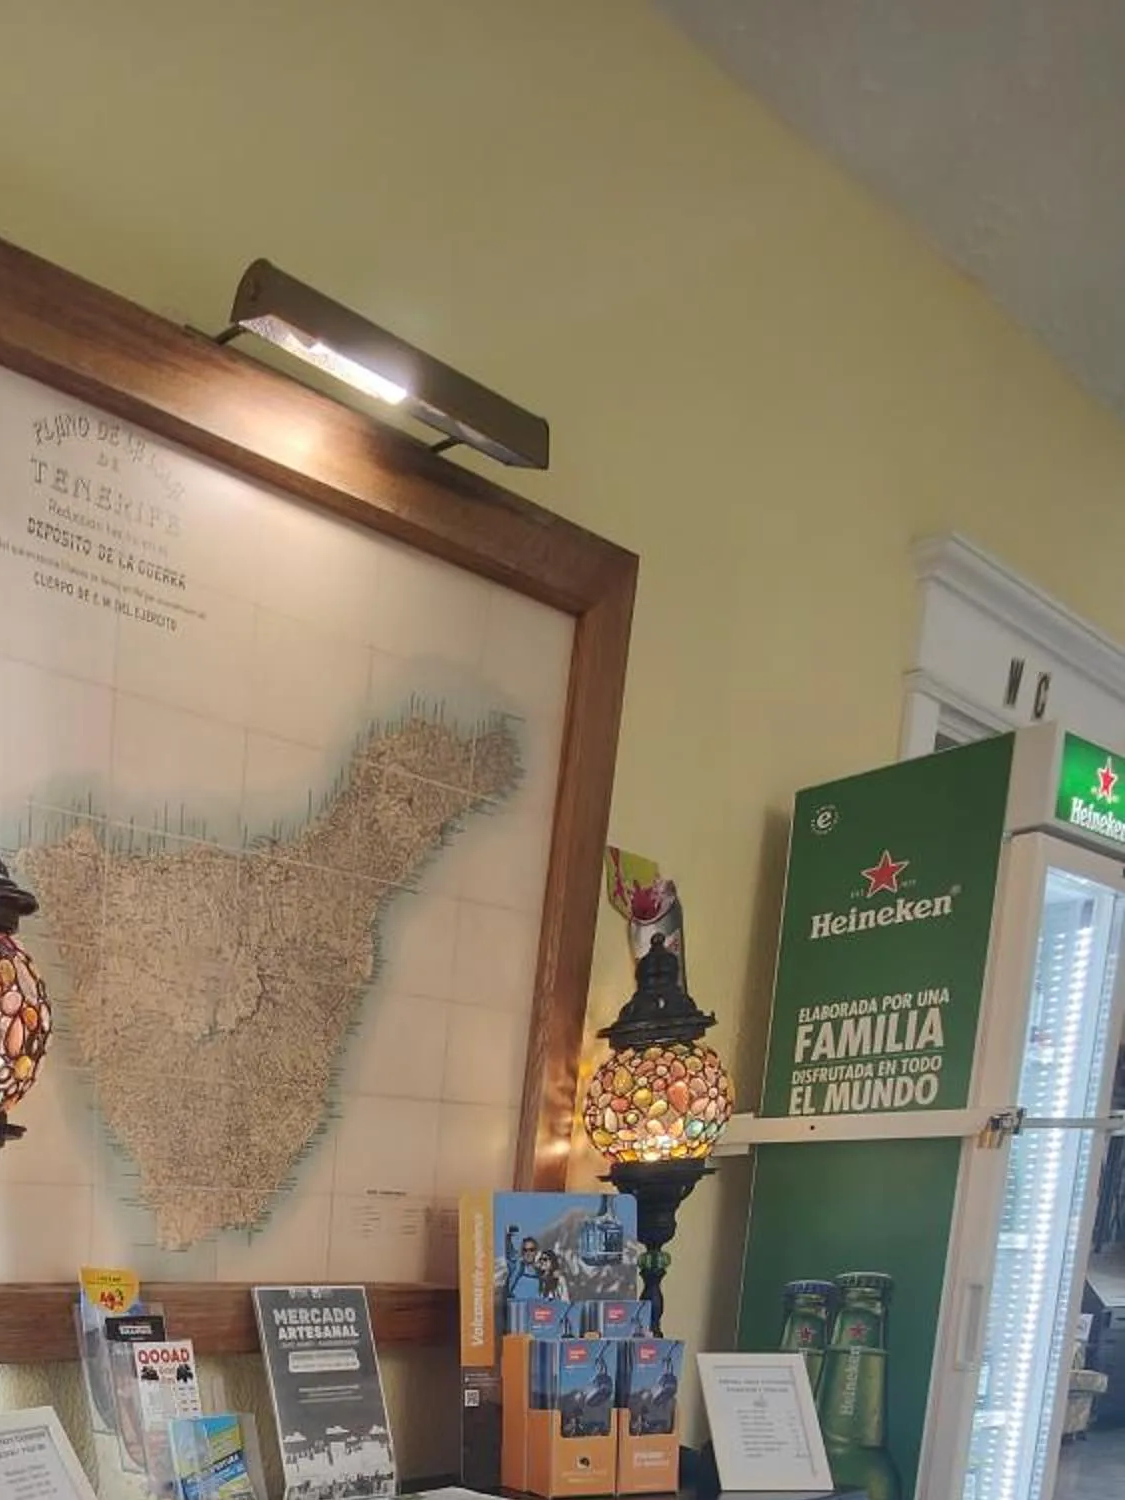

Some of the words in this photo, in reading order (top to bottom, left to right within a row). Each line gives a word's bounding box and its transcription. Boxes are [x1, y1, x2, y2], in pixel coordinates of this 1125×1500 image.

[29, 453, 183, 536] TENERIFE
[97, 543, 114, 564] DE
[1004, 657, 1052, 719] WC
[810, 895, 953, 939] Heineken
[798, 998, 879, 1023] ELABORADA
[881, 992, 913, 1011] POR
[916, 987, 950, 1007] UNA
[794, 1007, 945, 1064] FAMILIA
[791, 1063, 875, 1085] DISFRUTADA
[878, 1061, 897, 1076] EN
[902, 1055, 943, 1073] TODO
[789, 1085, 817, 1116] EL
[822, 1073, 940, 1114] MUNDO
[273, 1306, 356, 1326] MERCADO
[278, 1325, 360, 1341] ARTESANAL
